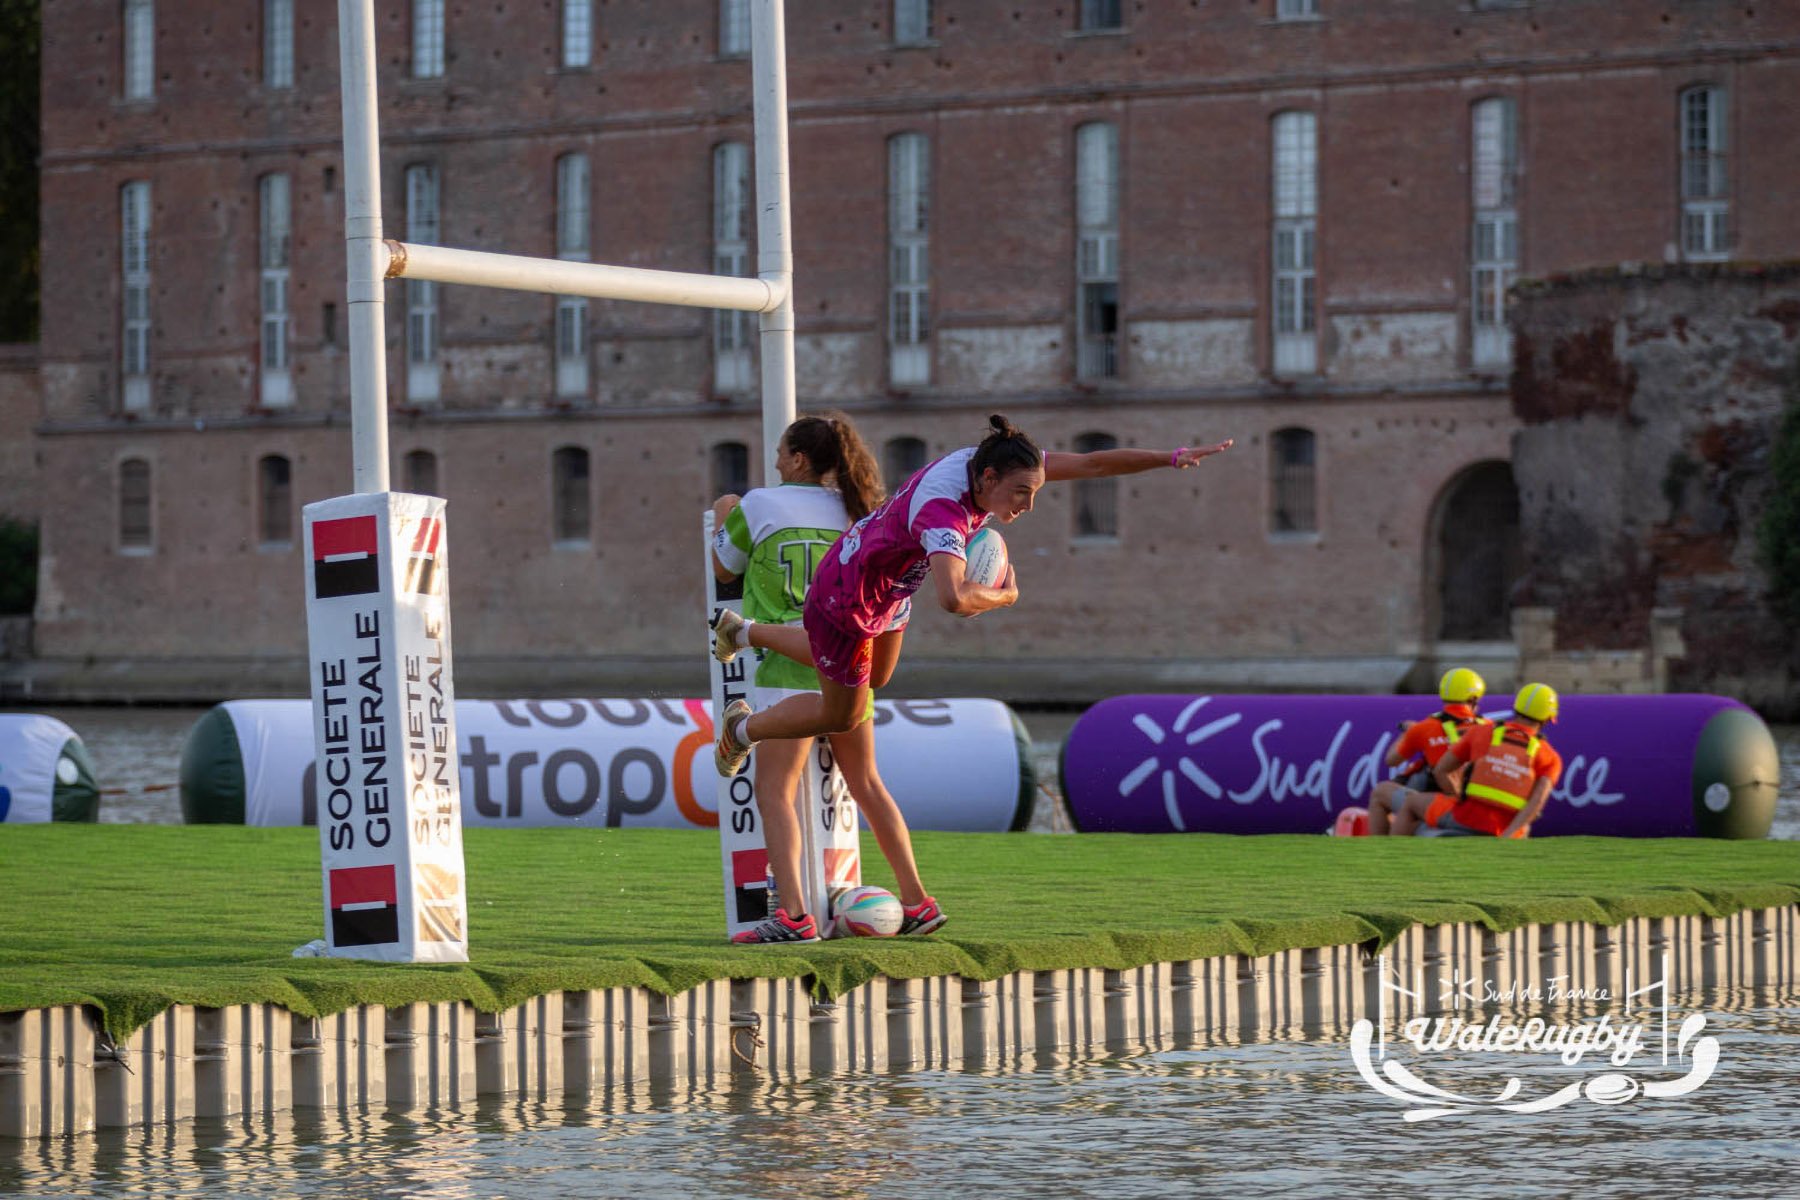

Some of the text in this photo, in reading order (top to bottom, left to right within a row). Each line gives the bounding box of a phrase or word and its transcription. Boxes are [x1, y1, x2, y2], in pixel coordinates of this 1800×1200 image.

[321, 658, 355, 851] SOCIETE
[354, 609, 392, 849] GENERALE
[405, 654, 430, 846] SOCIETE
[425, 611, 453, 848] GENERALE
[1227, 719, 1352, 812] Sud
